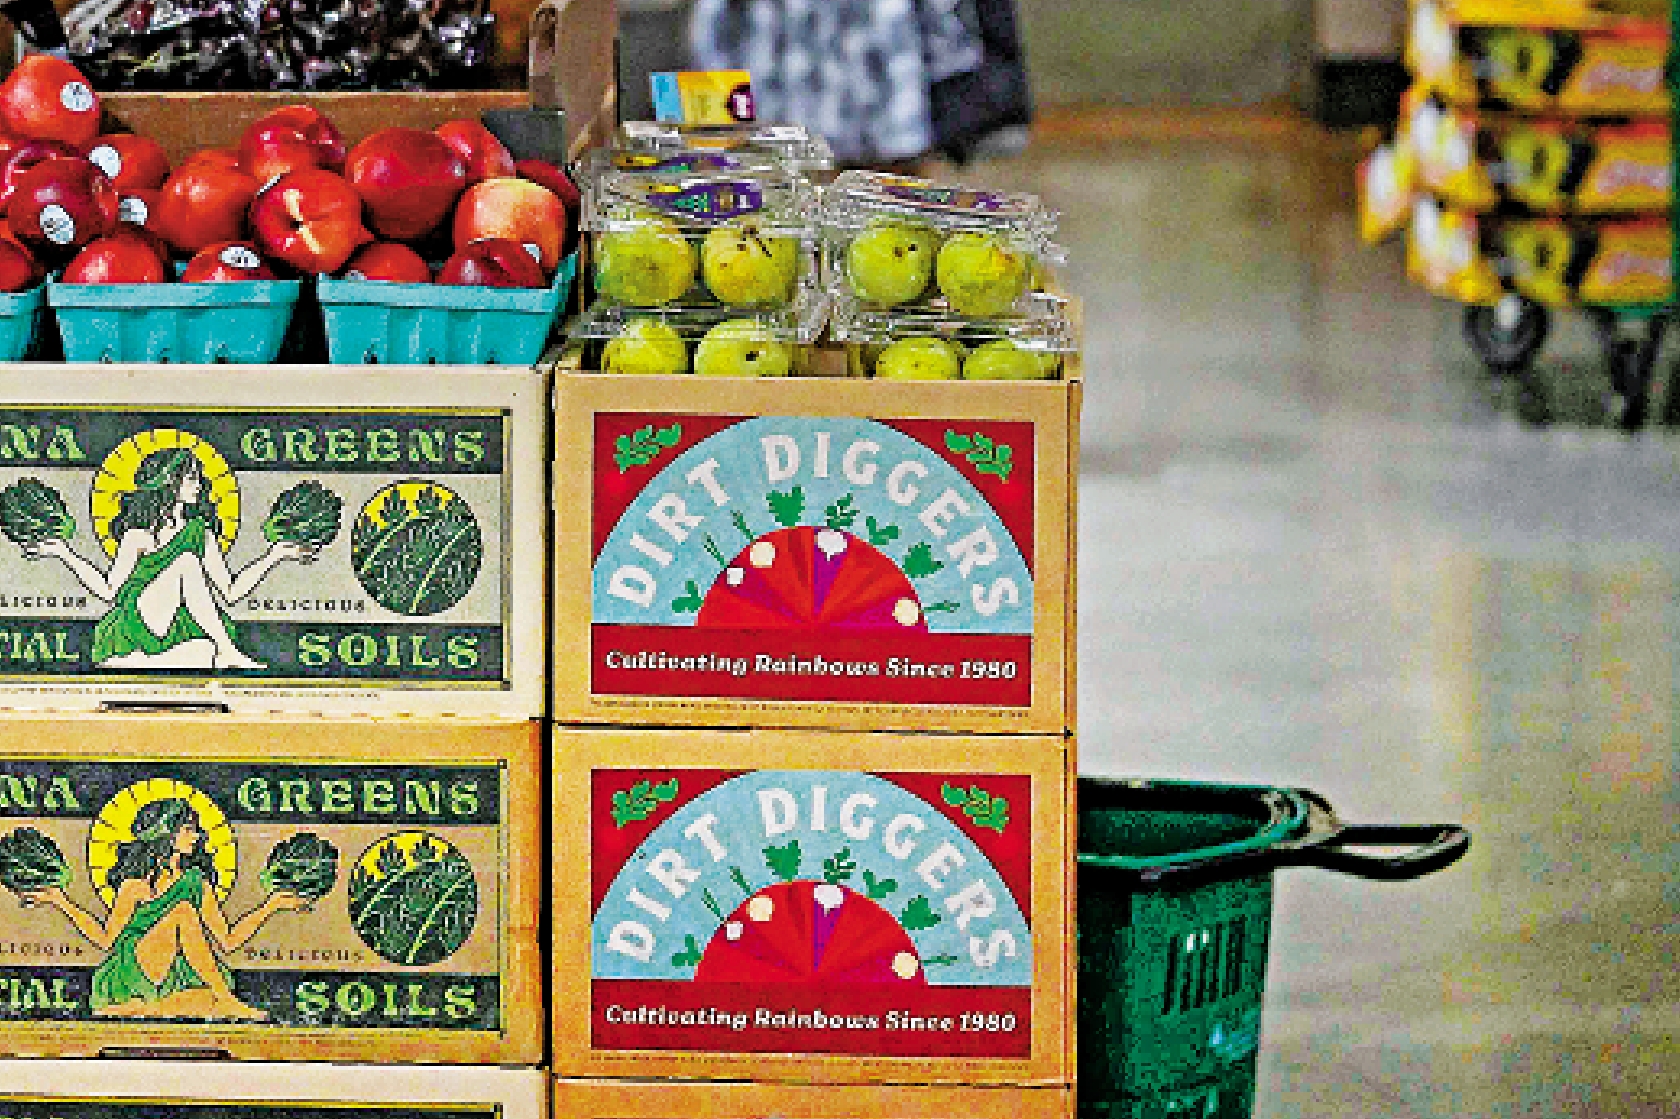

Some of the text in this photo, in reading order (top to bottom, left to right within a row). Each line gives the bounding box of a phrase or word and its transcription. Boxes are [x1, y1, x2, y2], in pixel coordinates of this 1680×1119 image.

[240, 427, 487, 464] GREENS
[606, 430, 1021, 617] DIRT DIGGERS
[247, 598, 367, 613] DELICIOUS
[297, 632, 480, 669] SOILS
[605, 649, 1017, 680] Cultivating Rainbows Since 1980
[236, 777, 480, 816] GREENS
[605, 785, 1017, 969] DIRT DIGGERS
[295, 981, 477, 1019] SOILS
[605, 1003, 1017, 1033] Cultivating Rainbows Since 1980
